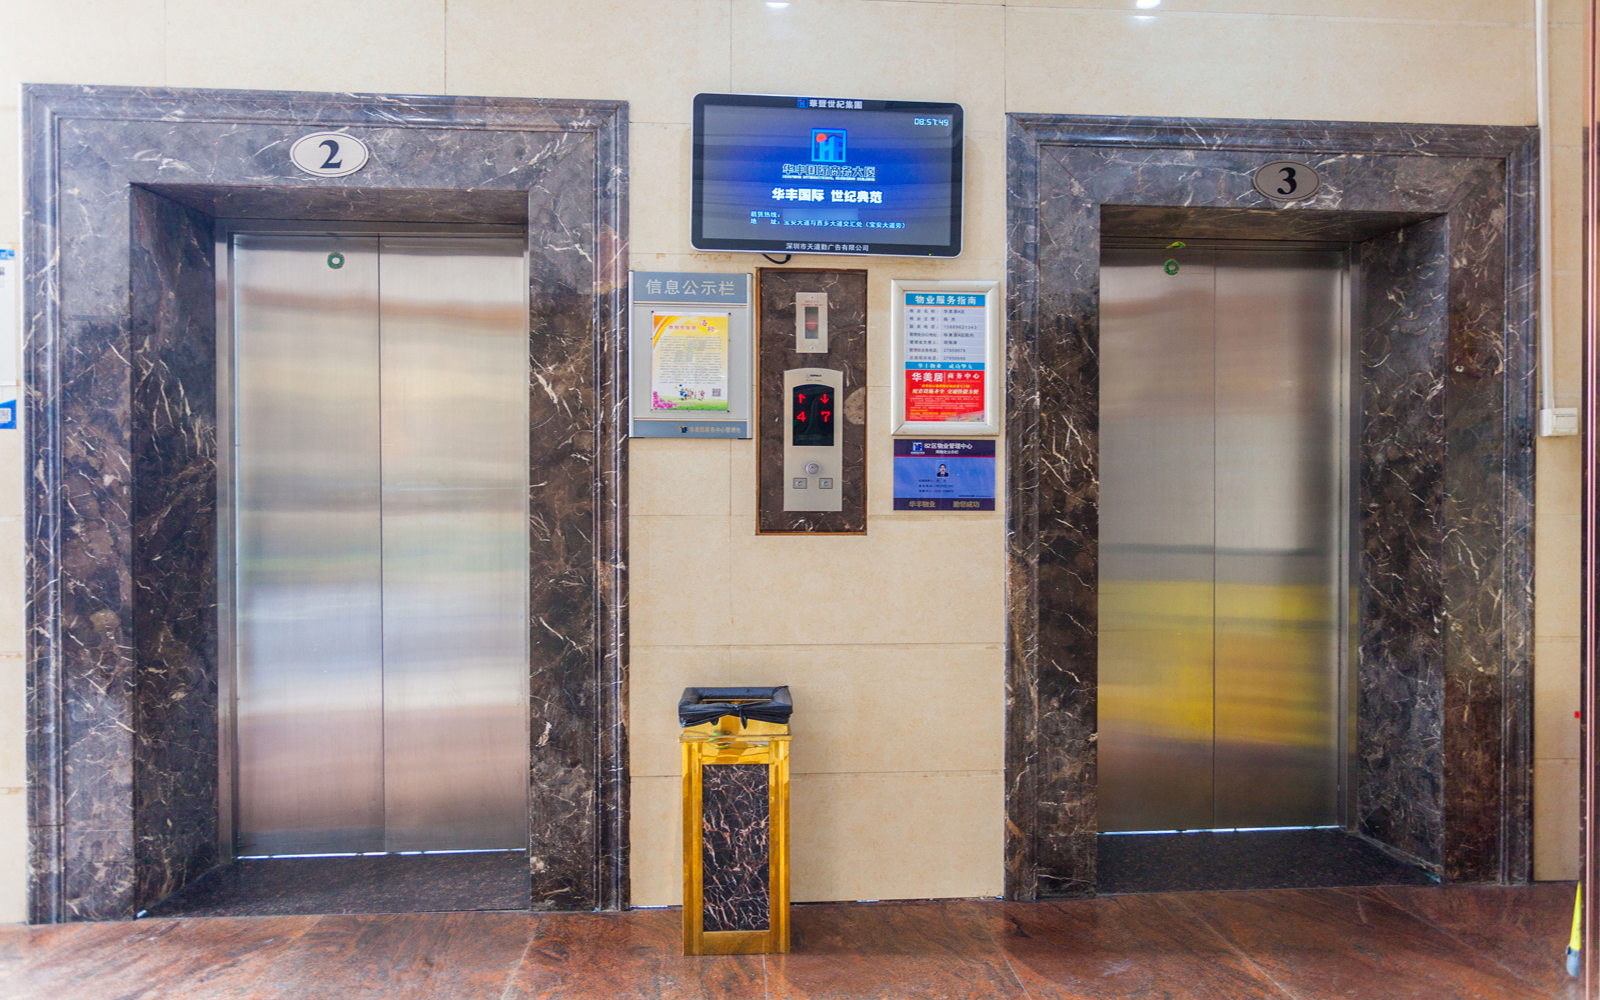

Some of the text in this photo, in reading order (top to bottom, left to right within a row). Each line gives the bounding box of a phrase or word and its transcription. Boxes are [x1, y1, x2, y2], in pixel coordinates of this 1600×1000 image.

[318, 139, 343, 168] 2
[782, 163, 876, 178] 华丰国际商务大厦
[1277, 167, 1297, 195] 3
[772, 187, 883, 204] 华丰国际 世纪典范
[645, 279, 735, 296] 信息公示栏
[915, 295, 977, 305] 物业服务指南
[911, 372, 980, 382] 华美居 商务中心
[796, 411, 831, 422] 4 7
